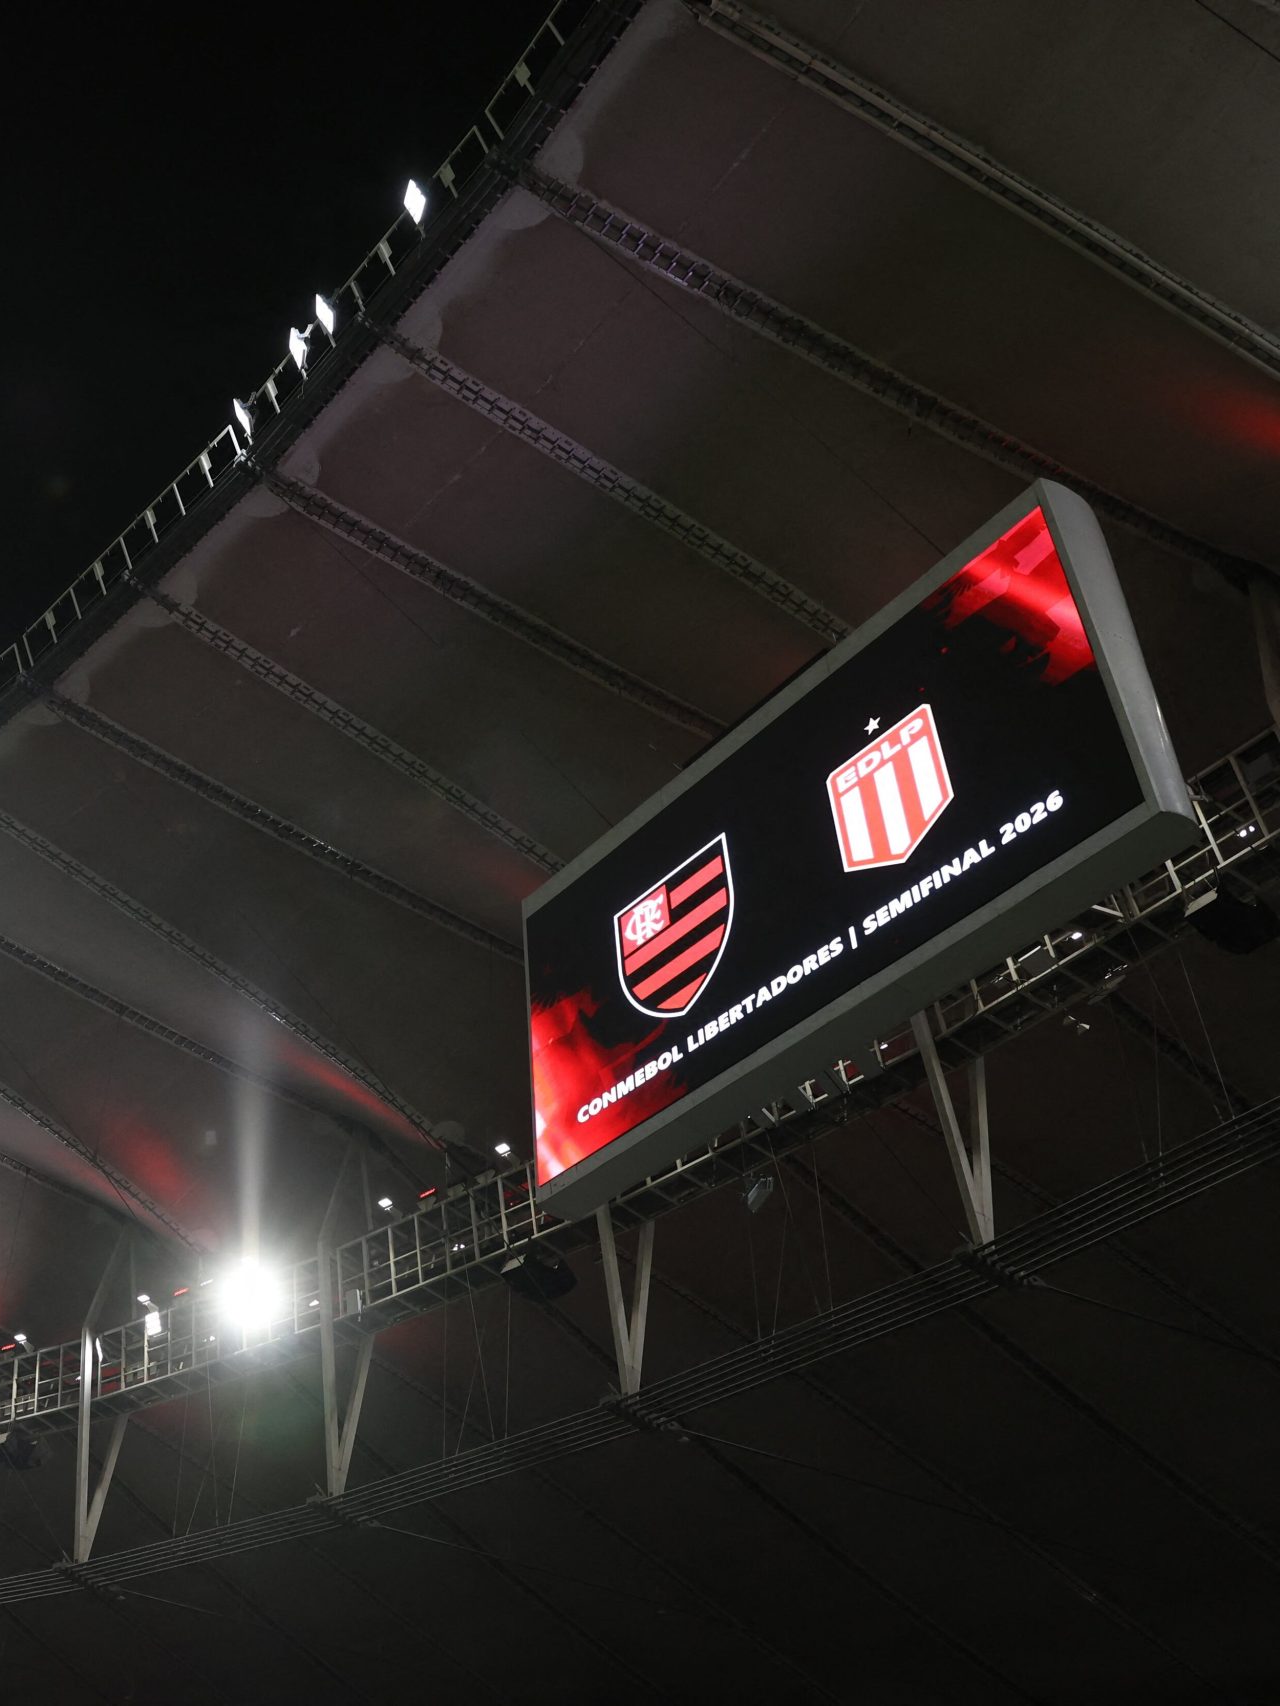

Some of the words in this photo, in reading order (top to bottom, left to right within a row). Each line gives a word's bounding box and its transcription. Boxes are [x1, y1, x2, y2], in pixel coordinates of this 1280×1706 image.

[836, 717, 925, 794] EDLP
[576, 1045, 684, 1123] CONMEBOL
[686, 936, 844, 1053] LIBERTADORES
[862, 838, 996, 936] SEMIFINAL
[999, 789, 1064, 846] 2026
